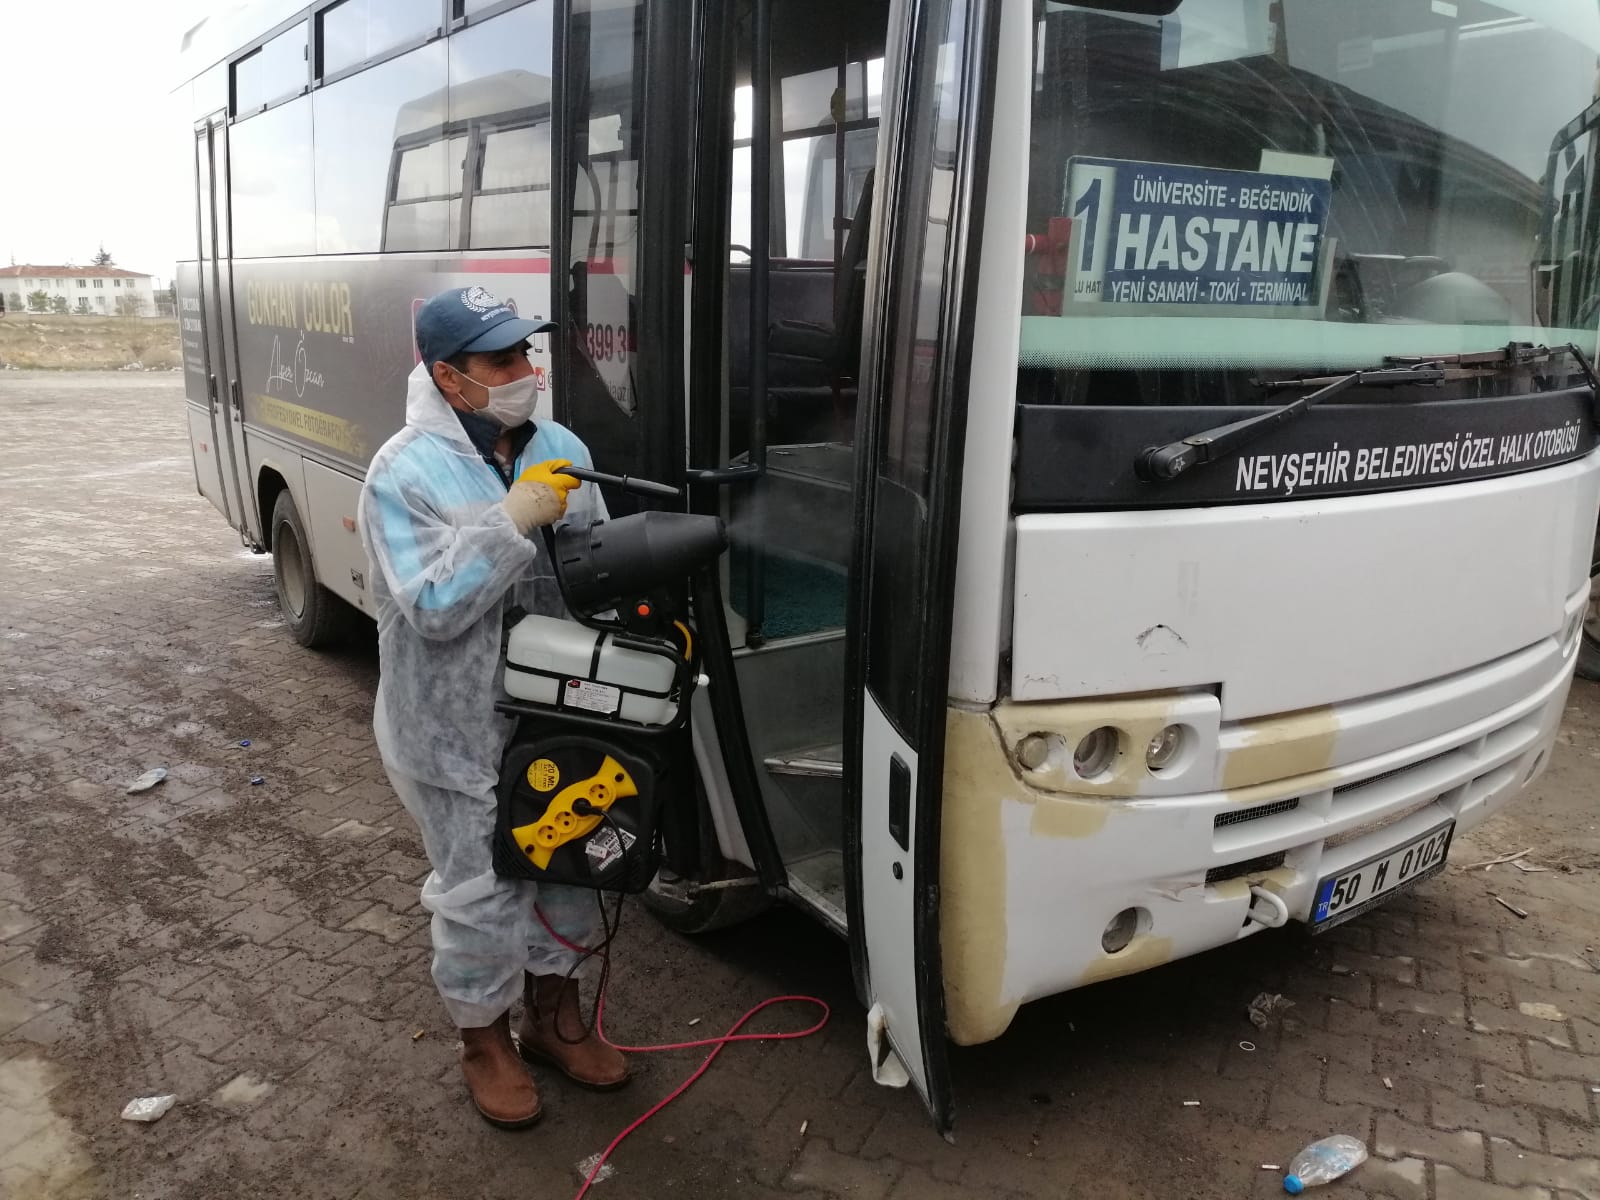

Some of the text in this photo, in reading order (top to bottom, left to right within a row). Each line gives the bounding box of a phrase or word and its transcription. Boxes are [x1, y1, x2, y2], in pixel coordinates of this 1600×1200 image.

[1133, 174, 1227, 207] ÜNİVERSİTE
[1239, 184, 1314, 213] BEĞENDİK
[1075, 178, 1102, 272] 1
[1114, 213, 1318, 273] HASTANE
[303, 280, 353, 336] COLOR
[1112, 275, 1145, 303] YENİ
[1147, 277, 1199, 303] SANAYİ
[1209, 277, 1240, 303] TOKİ
[1250, 278, 1309, 302] TERMİNAL
[1235, 442, 1350, 495] NEVŞEHİR
[1459, 432, 1495, 470] ÖZEL
[1497, 432, 1534, 465] HALK
[1533, 418, 1581, 460] OTOBÜSÜ
[1330, 831, 1447, 911] 50 M 0102
[1318, 901, 1328, 913] TR
